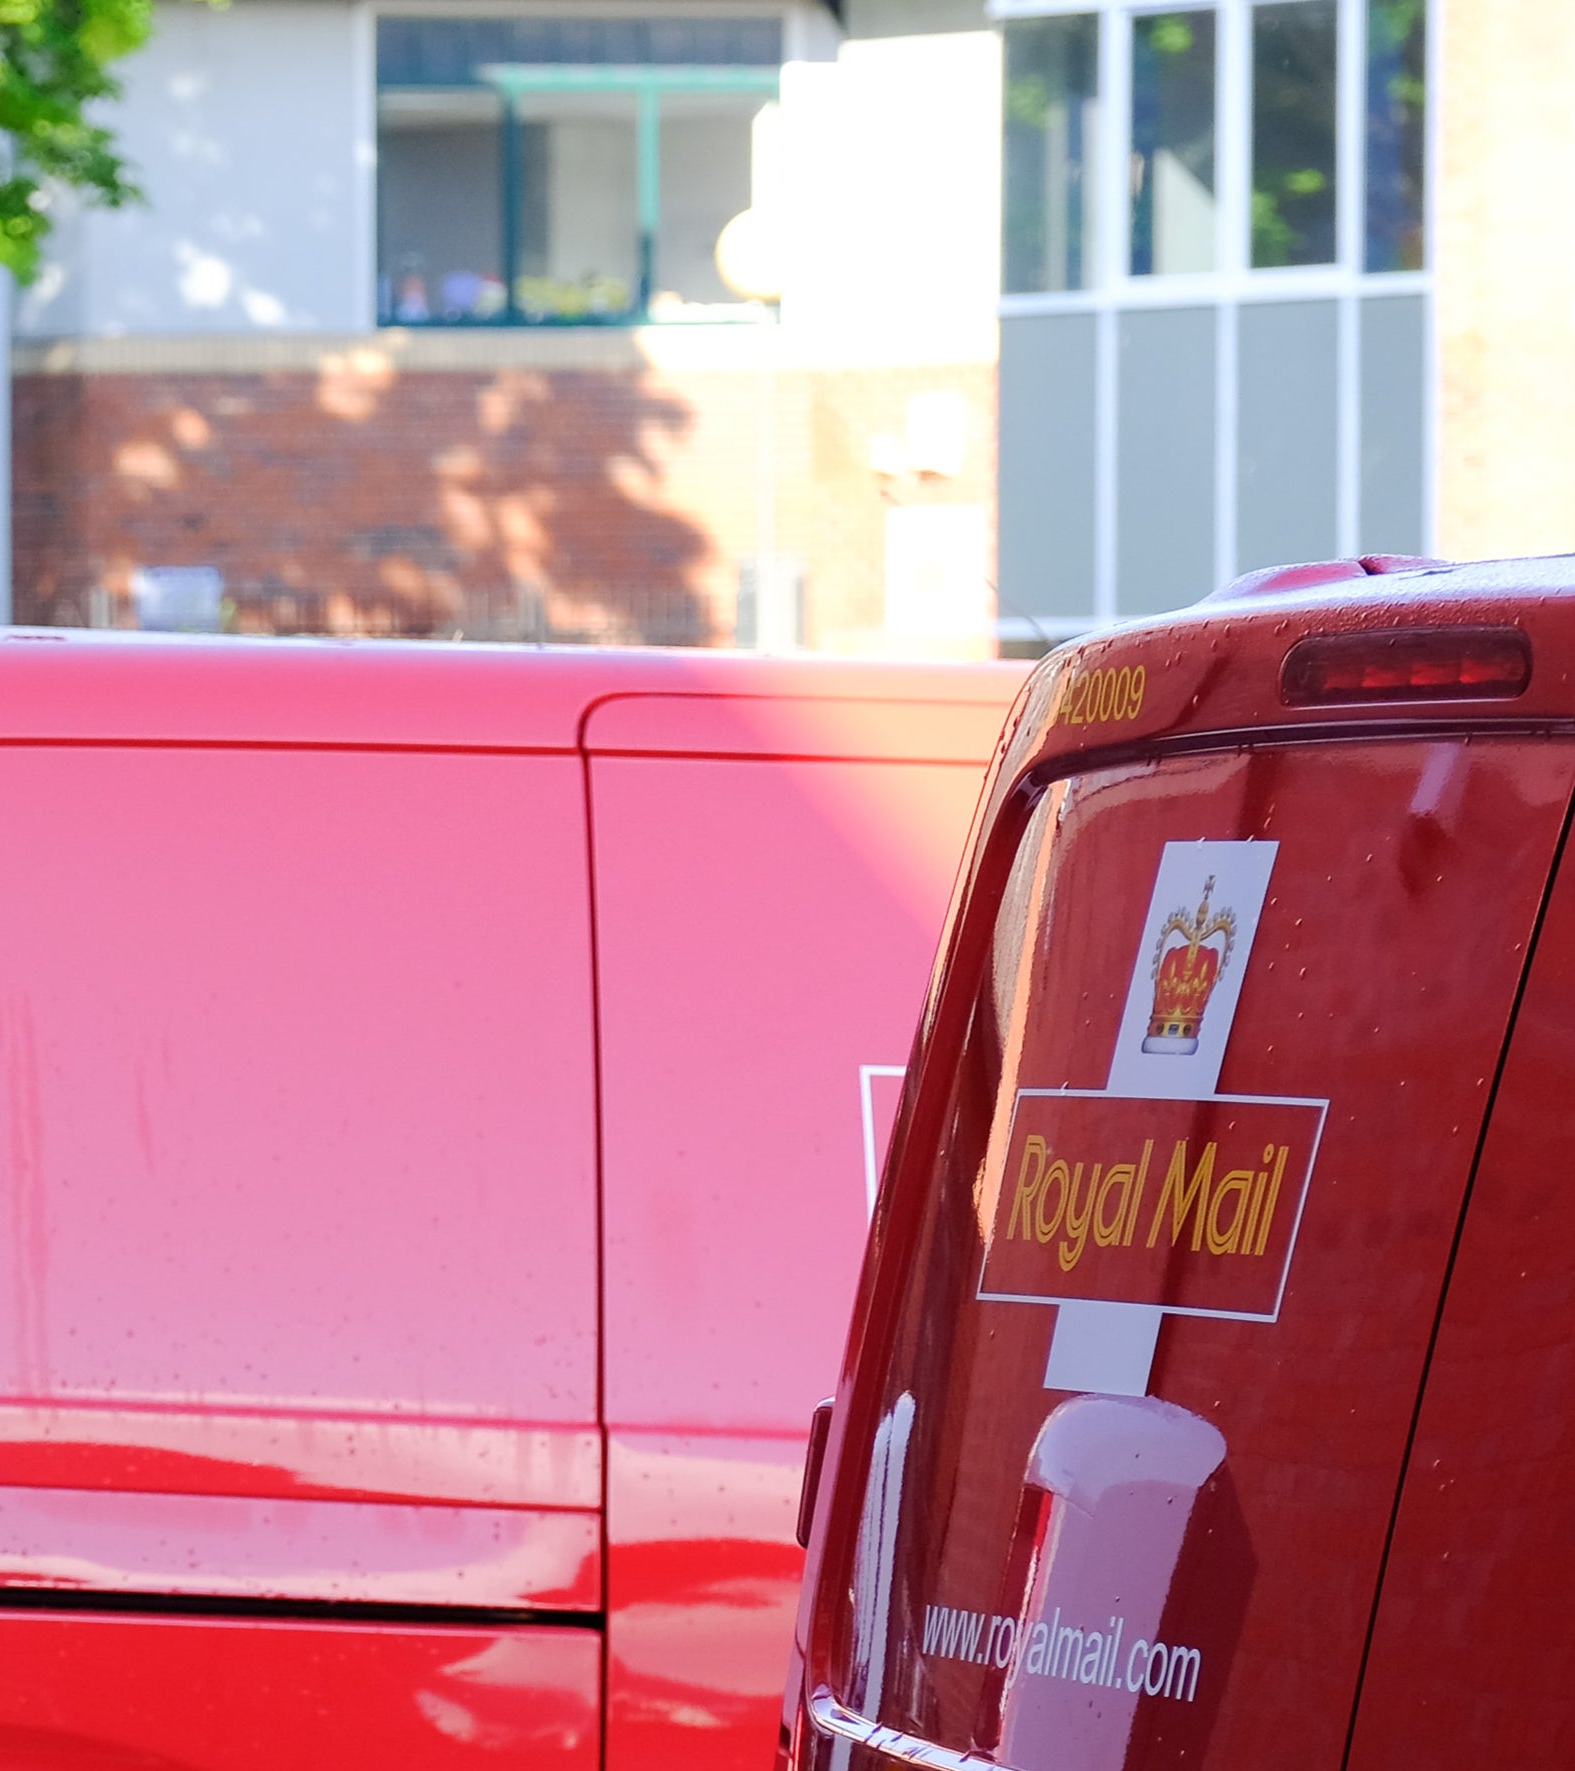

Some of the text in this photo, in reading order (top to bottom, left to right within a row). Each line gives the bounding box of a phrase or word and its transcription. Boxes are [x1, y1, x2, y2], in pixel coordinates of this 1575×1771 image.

[1006, 1134, 1289, 1272] Royal Mail
[922, 1603, 1201, 1702] www.royalmail.com
